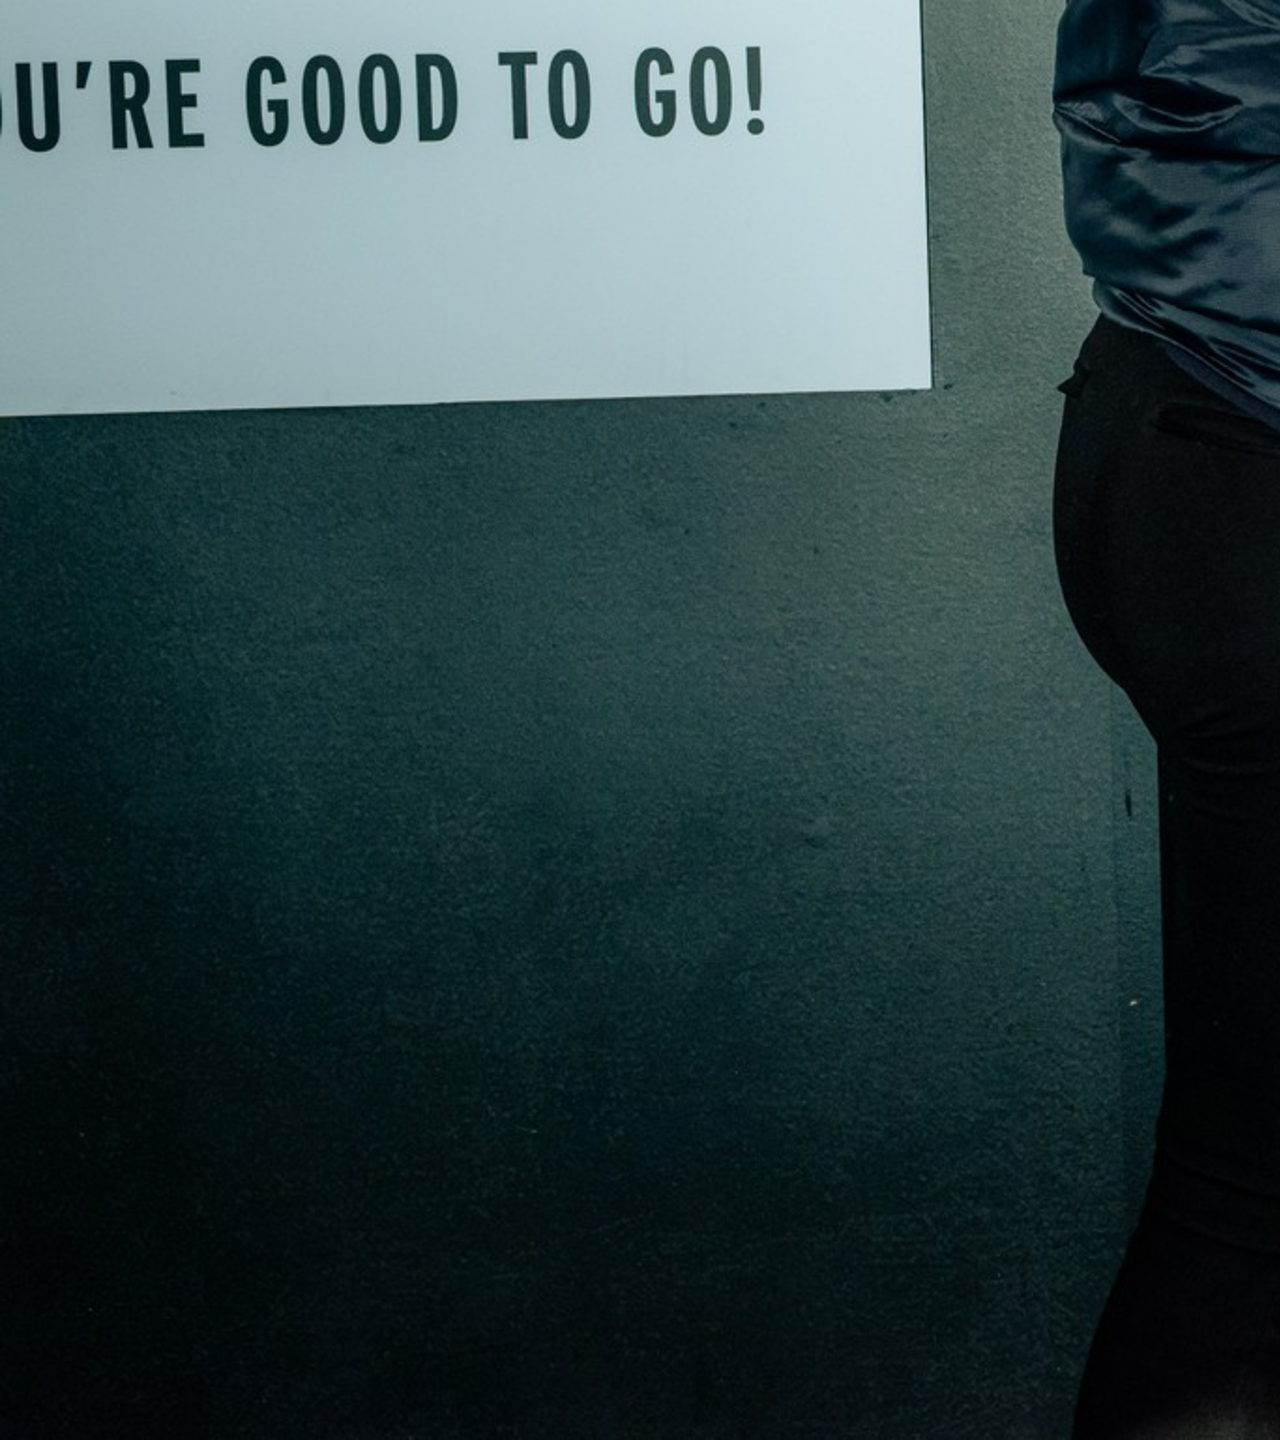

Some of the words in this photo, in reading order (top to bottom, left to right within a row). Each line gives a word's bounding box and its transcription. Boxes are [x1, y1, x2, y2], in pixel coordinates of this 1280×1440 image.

[0, 58, 205, 153] U'RE
[245, 54, 458, 148] GOOD
[497, 48, 593, 140] TO
[633, 46, 765, 138] GO!
